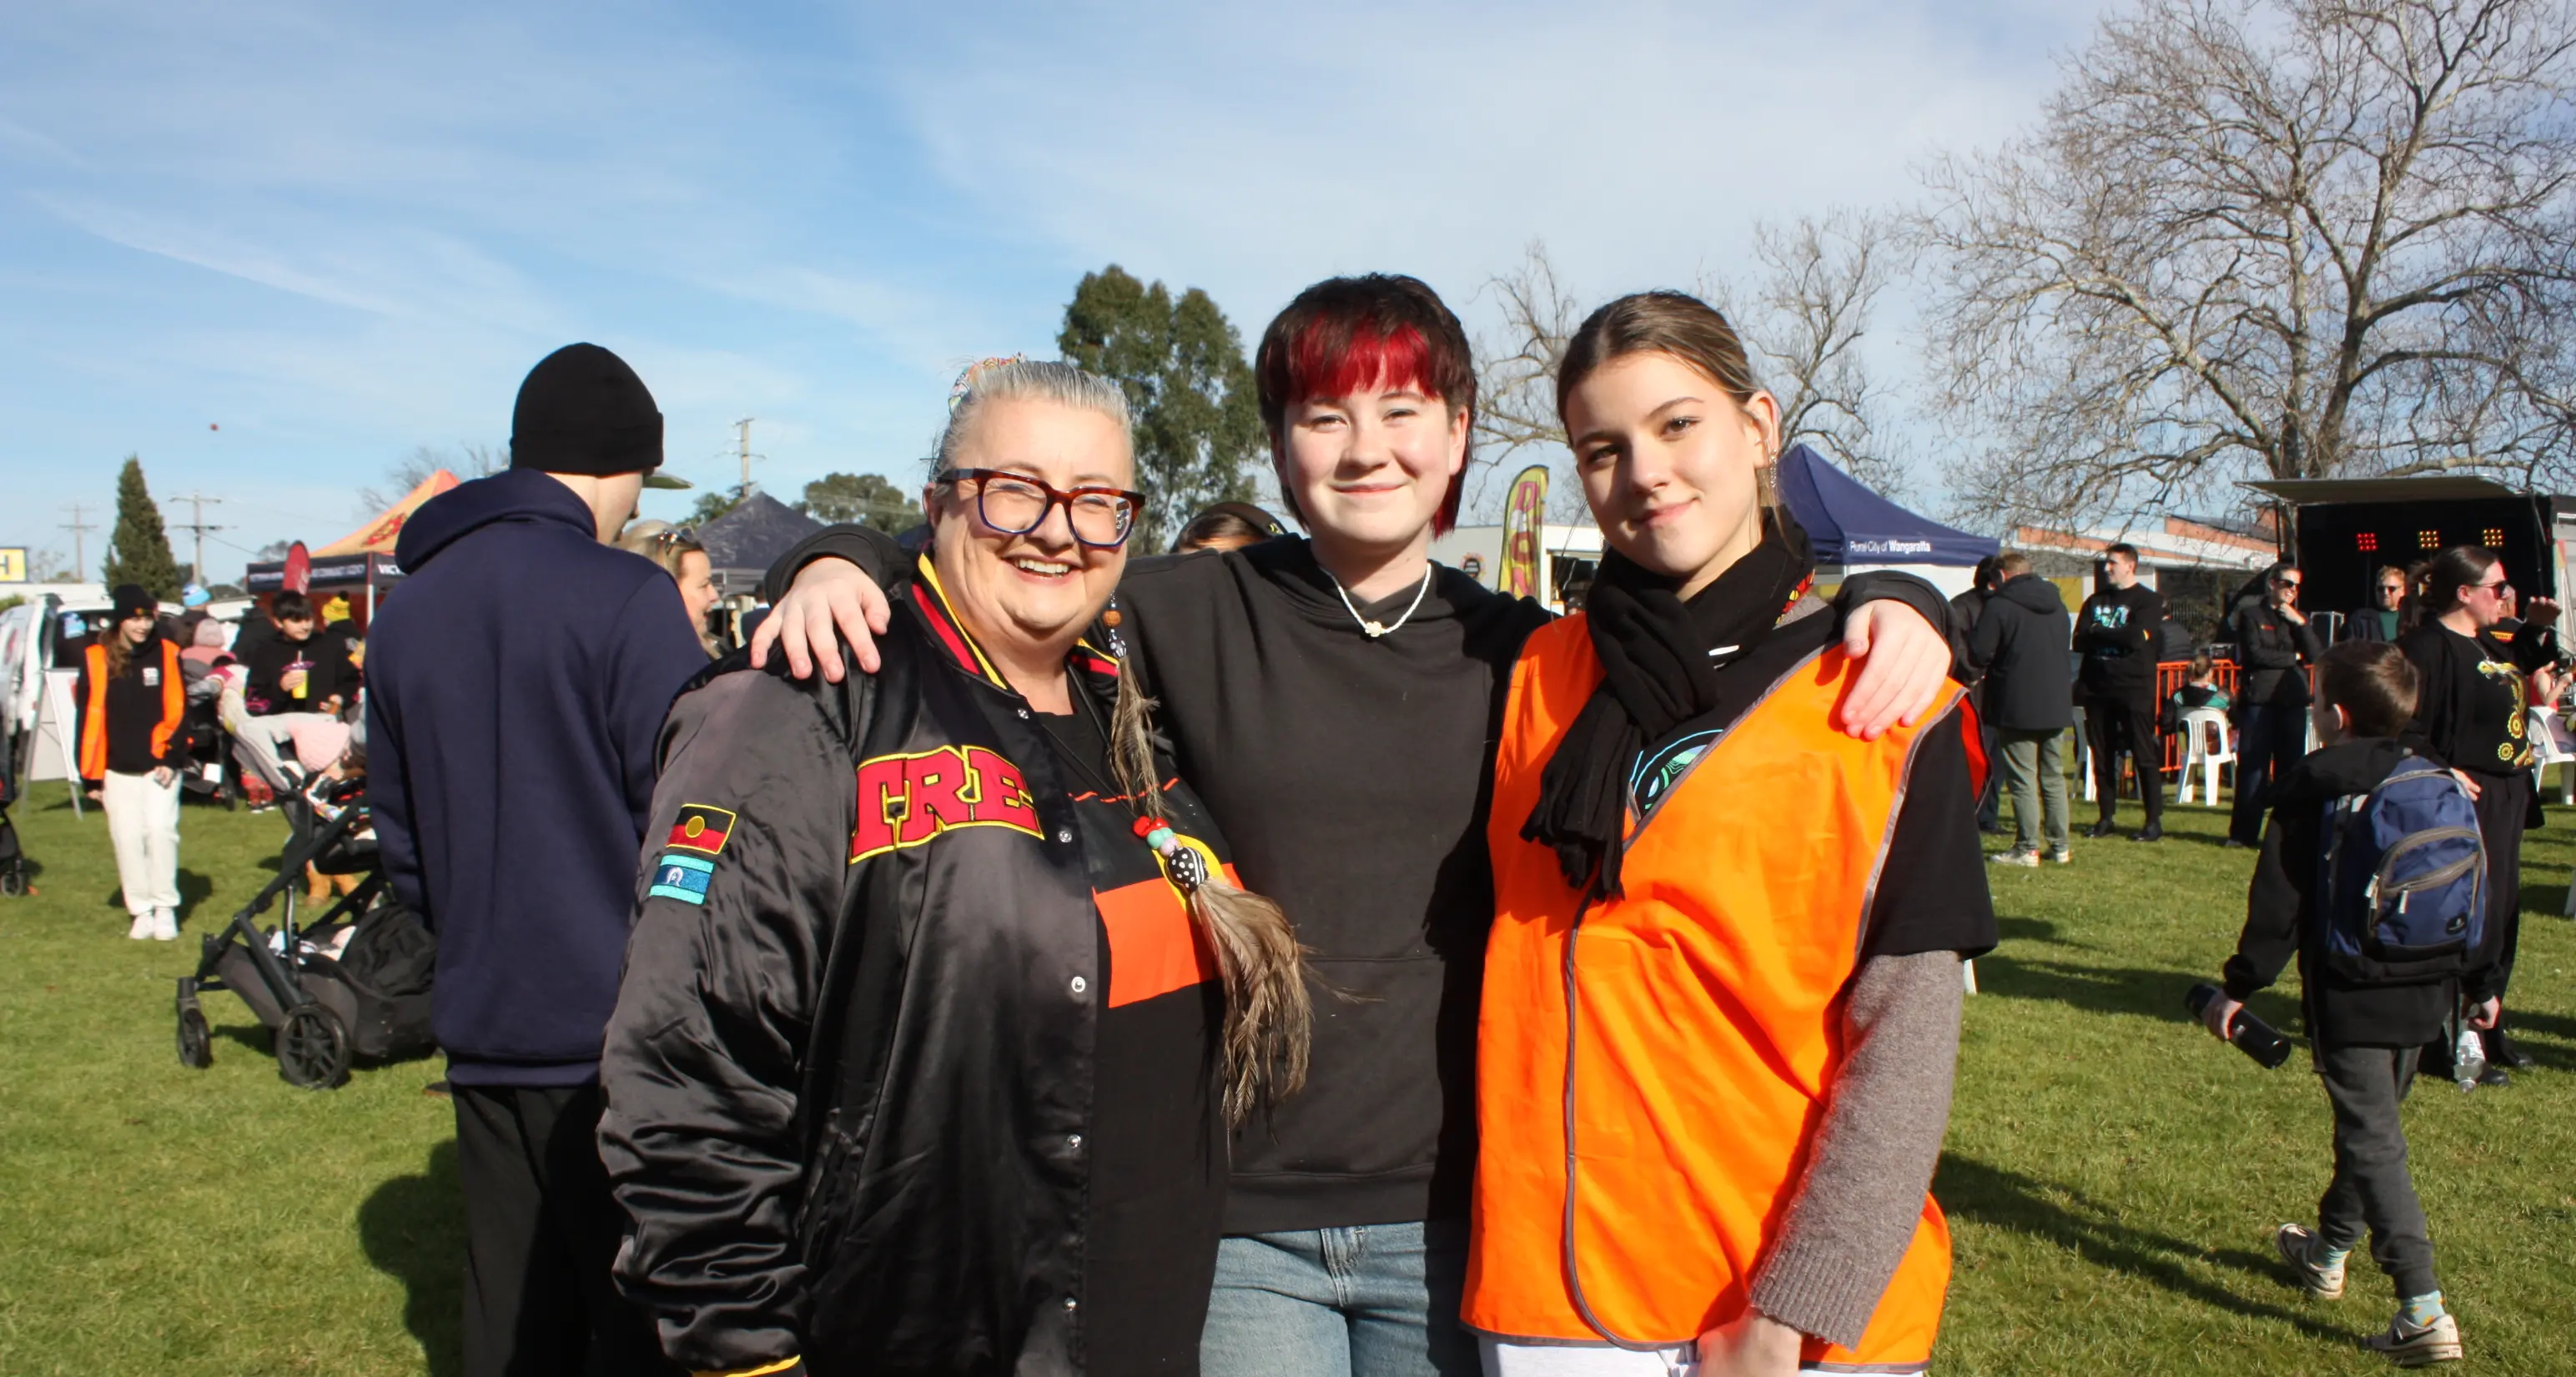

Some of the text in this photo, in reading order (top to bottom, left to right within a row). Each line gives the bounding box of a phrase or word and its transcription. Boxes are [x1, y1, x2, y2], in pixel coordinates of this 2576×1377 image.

[1849, 540, 1930, 554] Rural City of Wangaratta
